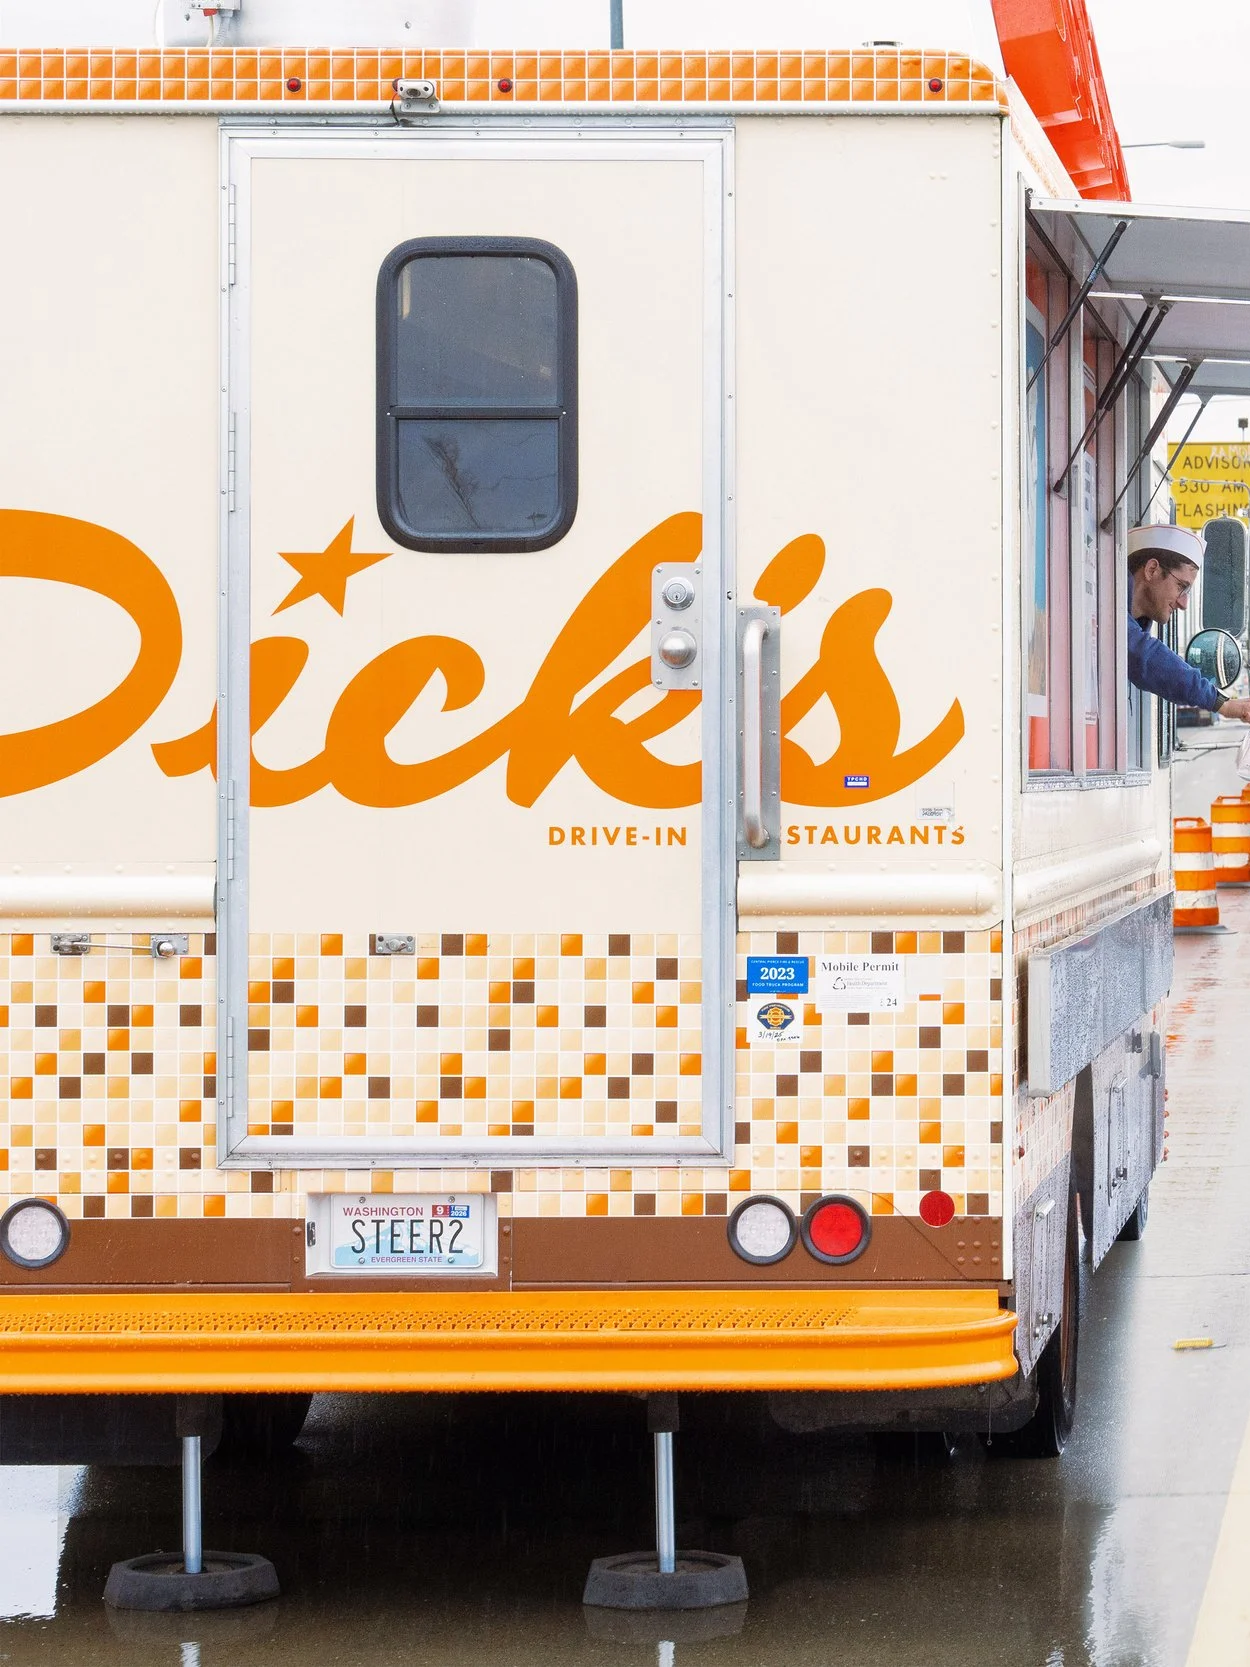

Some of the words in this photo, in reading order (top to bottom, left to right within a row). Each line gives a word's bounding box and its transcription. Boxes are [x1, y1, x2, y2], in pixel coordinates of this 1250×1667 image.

[1221, 479, 1245, 493] AM
[548, 826, 688, 846] DRIVE-IN
[821, 962, 859, 971] Mobile
[862, 961, 899, 972] Permit
[760, 967, 795, 980] 2023
[343, 1206, 424, 1217] WASHINGTON
[436, 1205, 445, 1216] 9
[351, 1219, 464, 1254] STEER2
